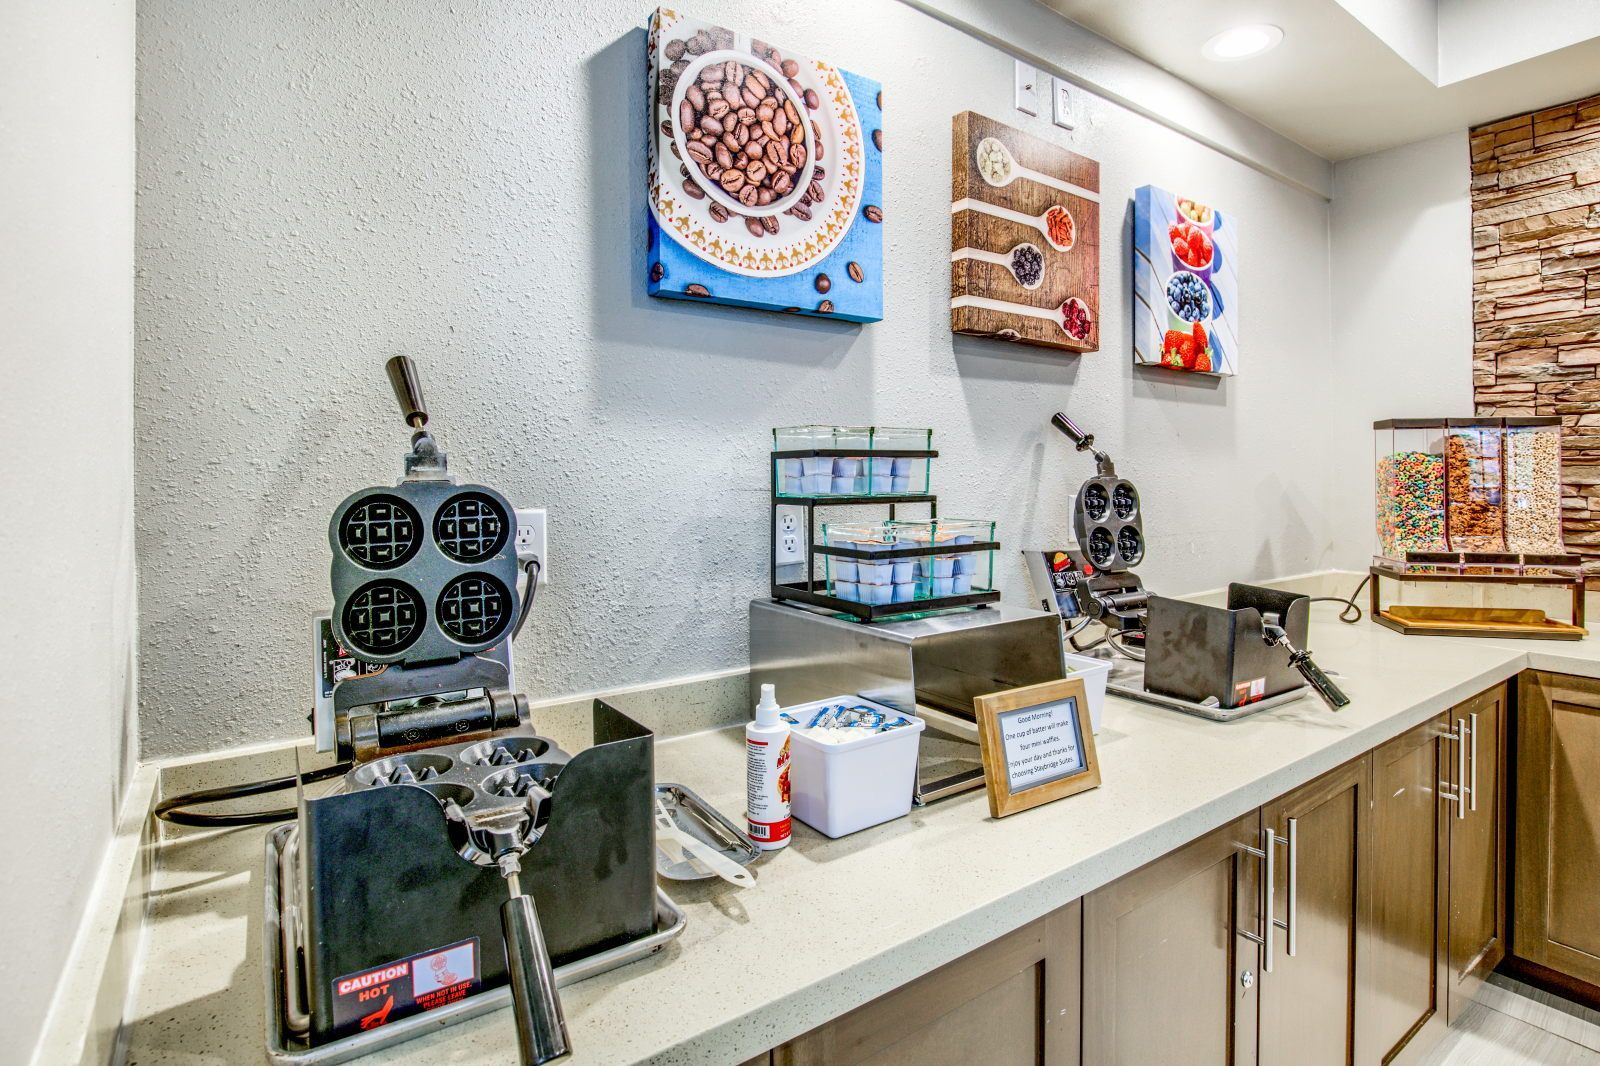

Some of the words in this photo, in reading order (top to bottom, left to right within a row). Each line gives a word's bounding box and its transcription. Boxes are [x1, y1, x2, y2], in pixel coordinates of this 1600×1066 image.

[1018, 716, 1031, 724] Good
[1032, 710, 1052, 720] Morning!
[1012, 769, 1033, 778] choosing
[1034, 762, 1059, 772] Staybridge
[340, 965, 408, 993] CAUTION
[359, 984, 390, 1002] HOT
[415, 993, 435, 1004] WHEN
[436, 988, 449, 998] NOT
[423, 996, 446, 1009] PLEASE
[447, 989, 467, 1001] LEAVE
